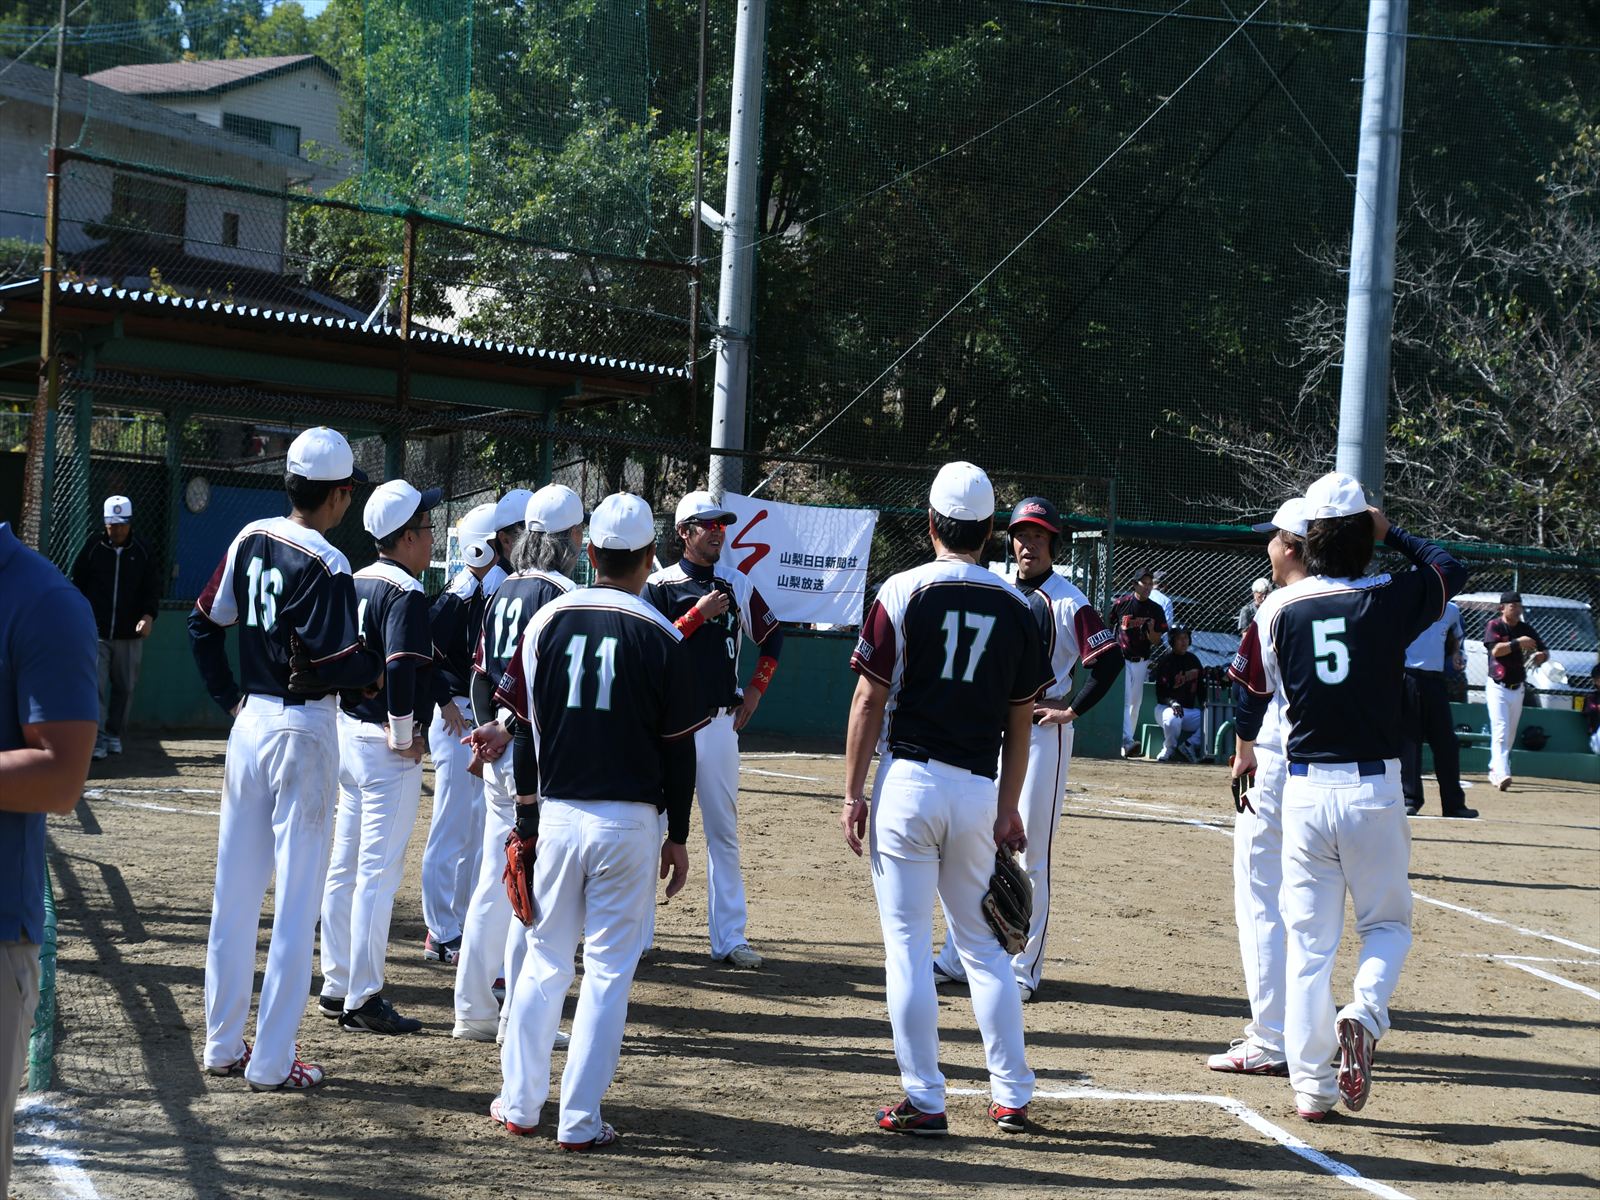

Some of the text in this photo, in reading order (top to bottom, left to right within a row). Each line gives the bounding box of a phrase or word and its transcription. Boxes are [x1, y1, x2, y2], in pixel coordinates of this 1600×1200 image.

[777, 574, 824, 591] 山梨放送
[780, 552, 858, 569] 山梨日日新聞社
[493, 597, 523, 658] 12
[725, 636, 736, 660] 0
[940, 610, 997, 682] 17
[1312, 616, 1350, 685] 5
[565, 634, 618, 710] 11
